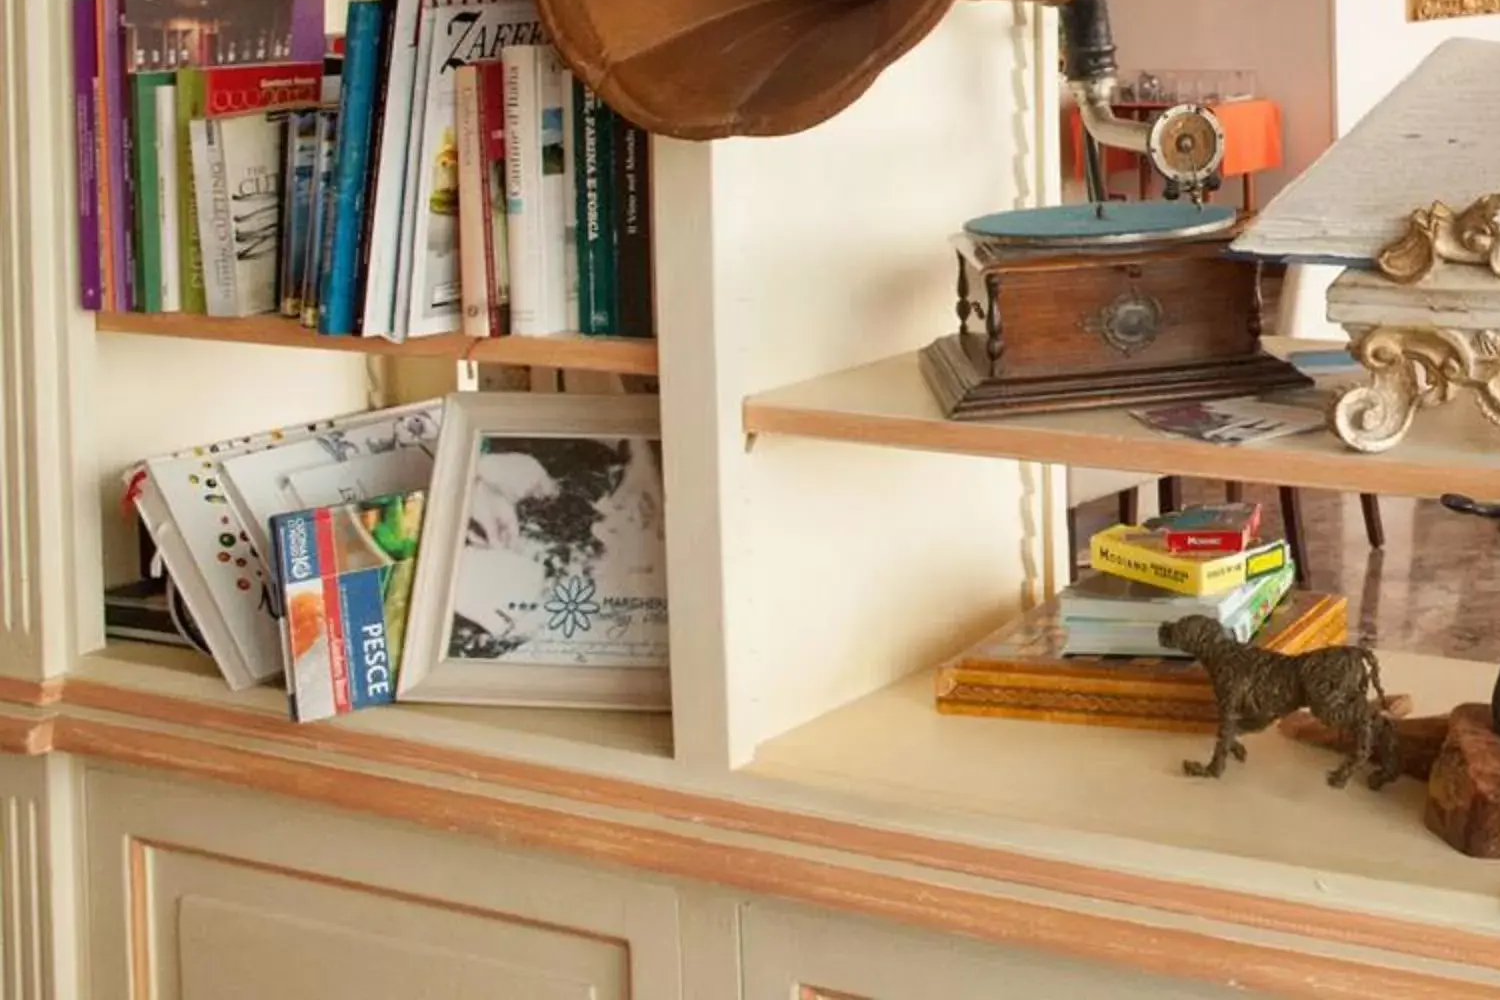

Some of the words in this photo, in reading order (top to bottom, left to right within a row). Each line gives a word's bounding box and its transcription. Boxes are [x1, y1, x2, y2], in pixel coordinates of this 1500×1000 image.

[509, 129, 523, 198] Cantine
[585, 116, 598, 175] FARINA
[211, 161, 230, 244] CUTTING
[586, 192, 600, 242] FORCA
[626, 194, 637, 224] Vino
[361, 622, 391, 698] PESCE
